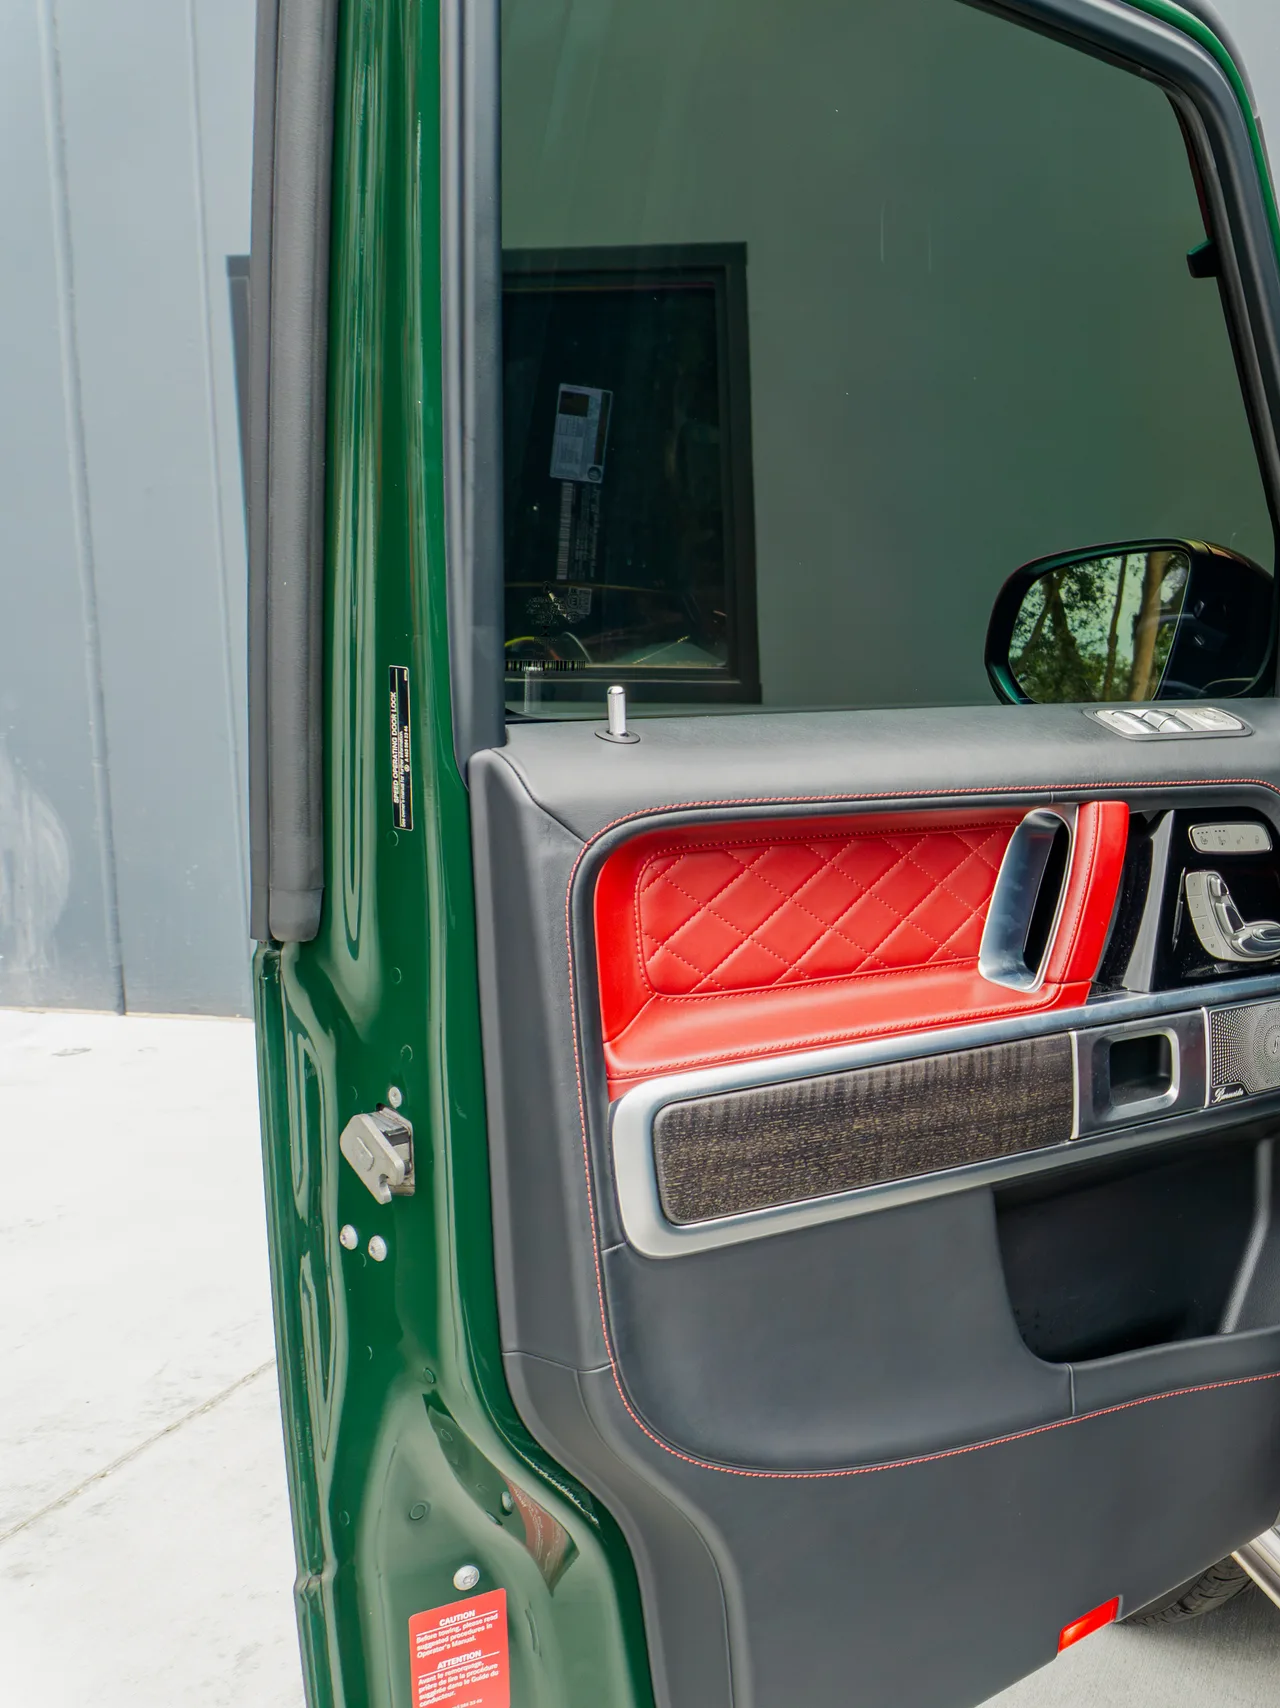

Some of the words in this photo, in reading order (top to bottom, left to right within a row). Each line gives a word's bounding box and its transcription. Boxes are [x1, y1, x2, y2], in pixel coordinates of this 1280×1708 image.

[390, 714, 398, 736] DOOR
[391, 737, 399, 779] OPERATING
[439, 1610, 476, 1626] CAUTION
[486, 1622, 493, 1630] in
[437, 1650, 482, 1669] ATTENTION
